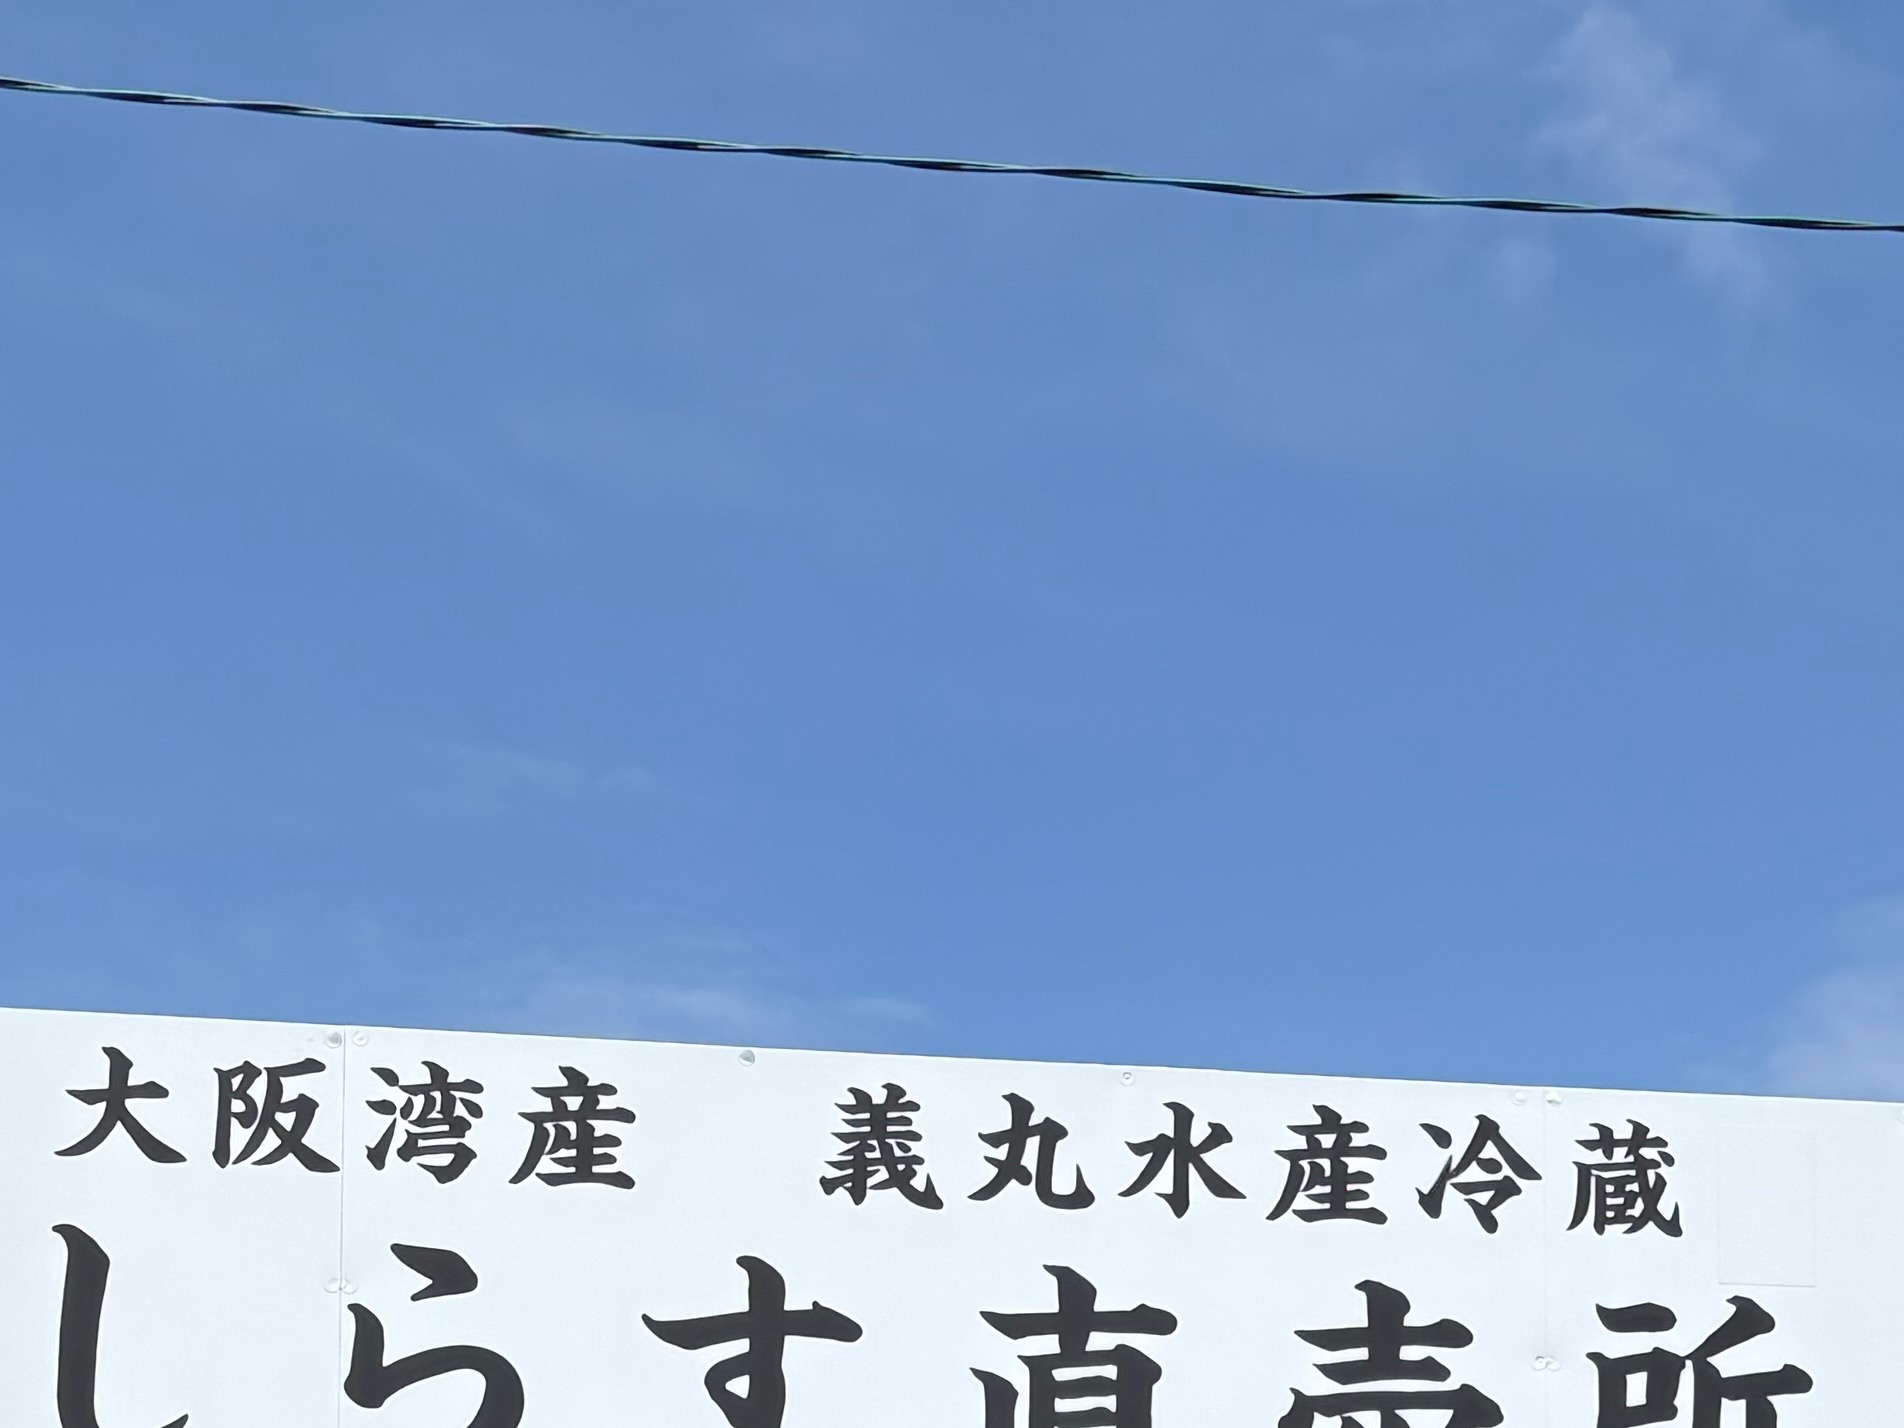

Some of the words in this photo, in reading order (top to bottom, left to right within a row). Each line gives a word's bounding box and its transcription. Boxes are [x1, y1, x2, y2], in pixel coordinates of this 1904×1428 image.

[53, 1045, 637, 1191] 大阪湾産
[818, 1081, 1684, 1239] 義丸水産冷蔵
